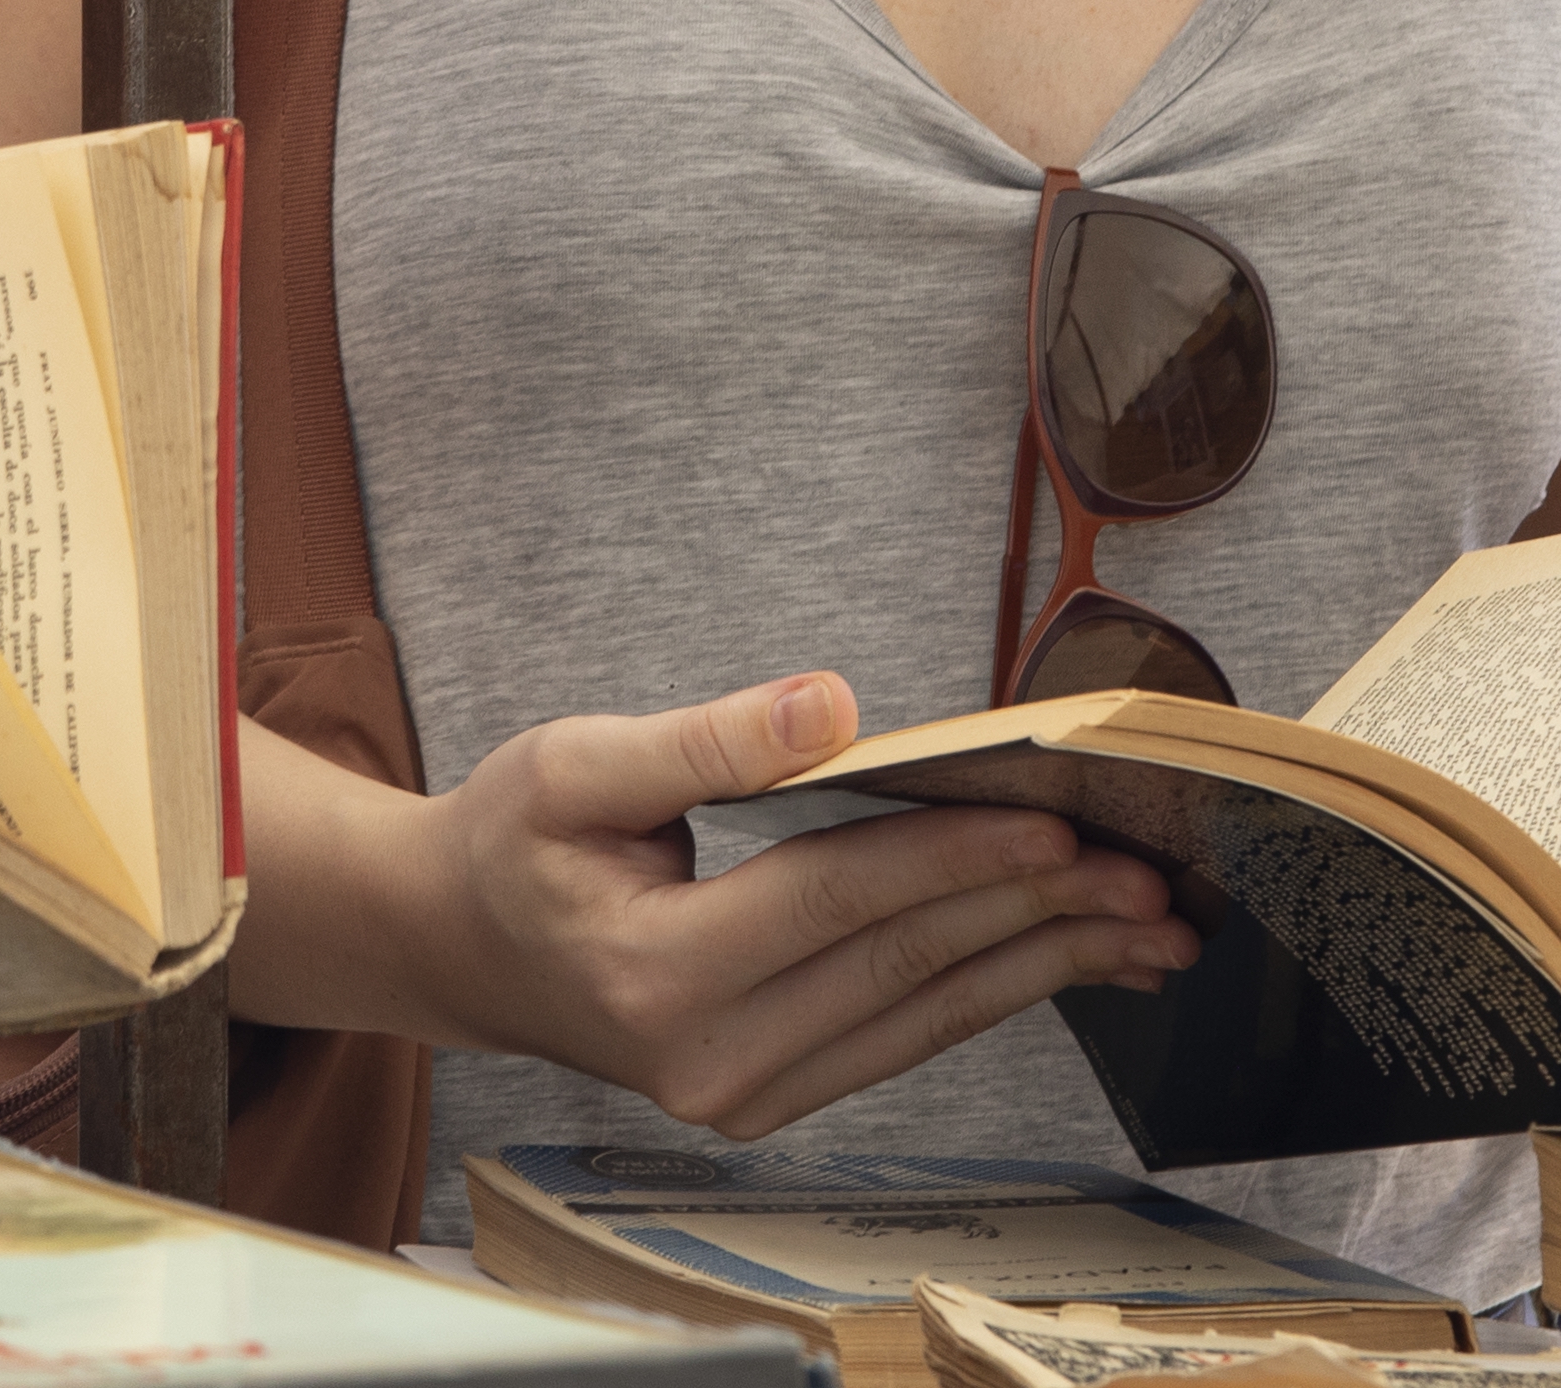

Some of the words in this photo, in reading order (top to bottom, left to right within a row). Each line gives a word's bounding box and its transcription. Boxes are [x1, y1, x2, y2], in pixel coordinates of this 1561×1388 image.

[6, 353, 20, 387] que
[40, 352, 52, 392] FRAY
[0, 387, 14, 450] escolta
[13, 400, 31, 460] quería
[5, 459, 18, 481] de
[47, 407, 64, 491] JUNÍPERO
[8, 491, 20, 534] doce
[23, 473, 32, 505] con
[26, 518, 39, 536] el
[59, 502, 70, 561] SERRA,
[6, 543, 25, 622] soldados
[27, 548, 41, 600] barco
[63, 573, 73, 661] FUNDADOR
[9, 632, 22, 673] para
[26, 613, 43, 705] despachar
[65, 672, 74, 693] DE
